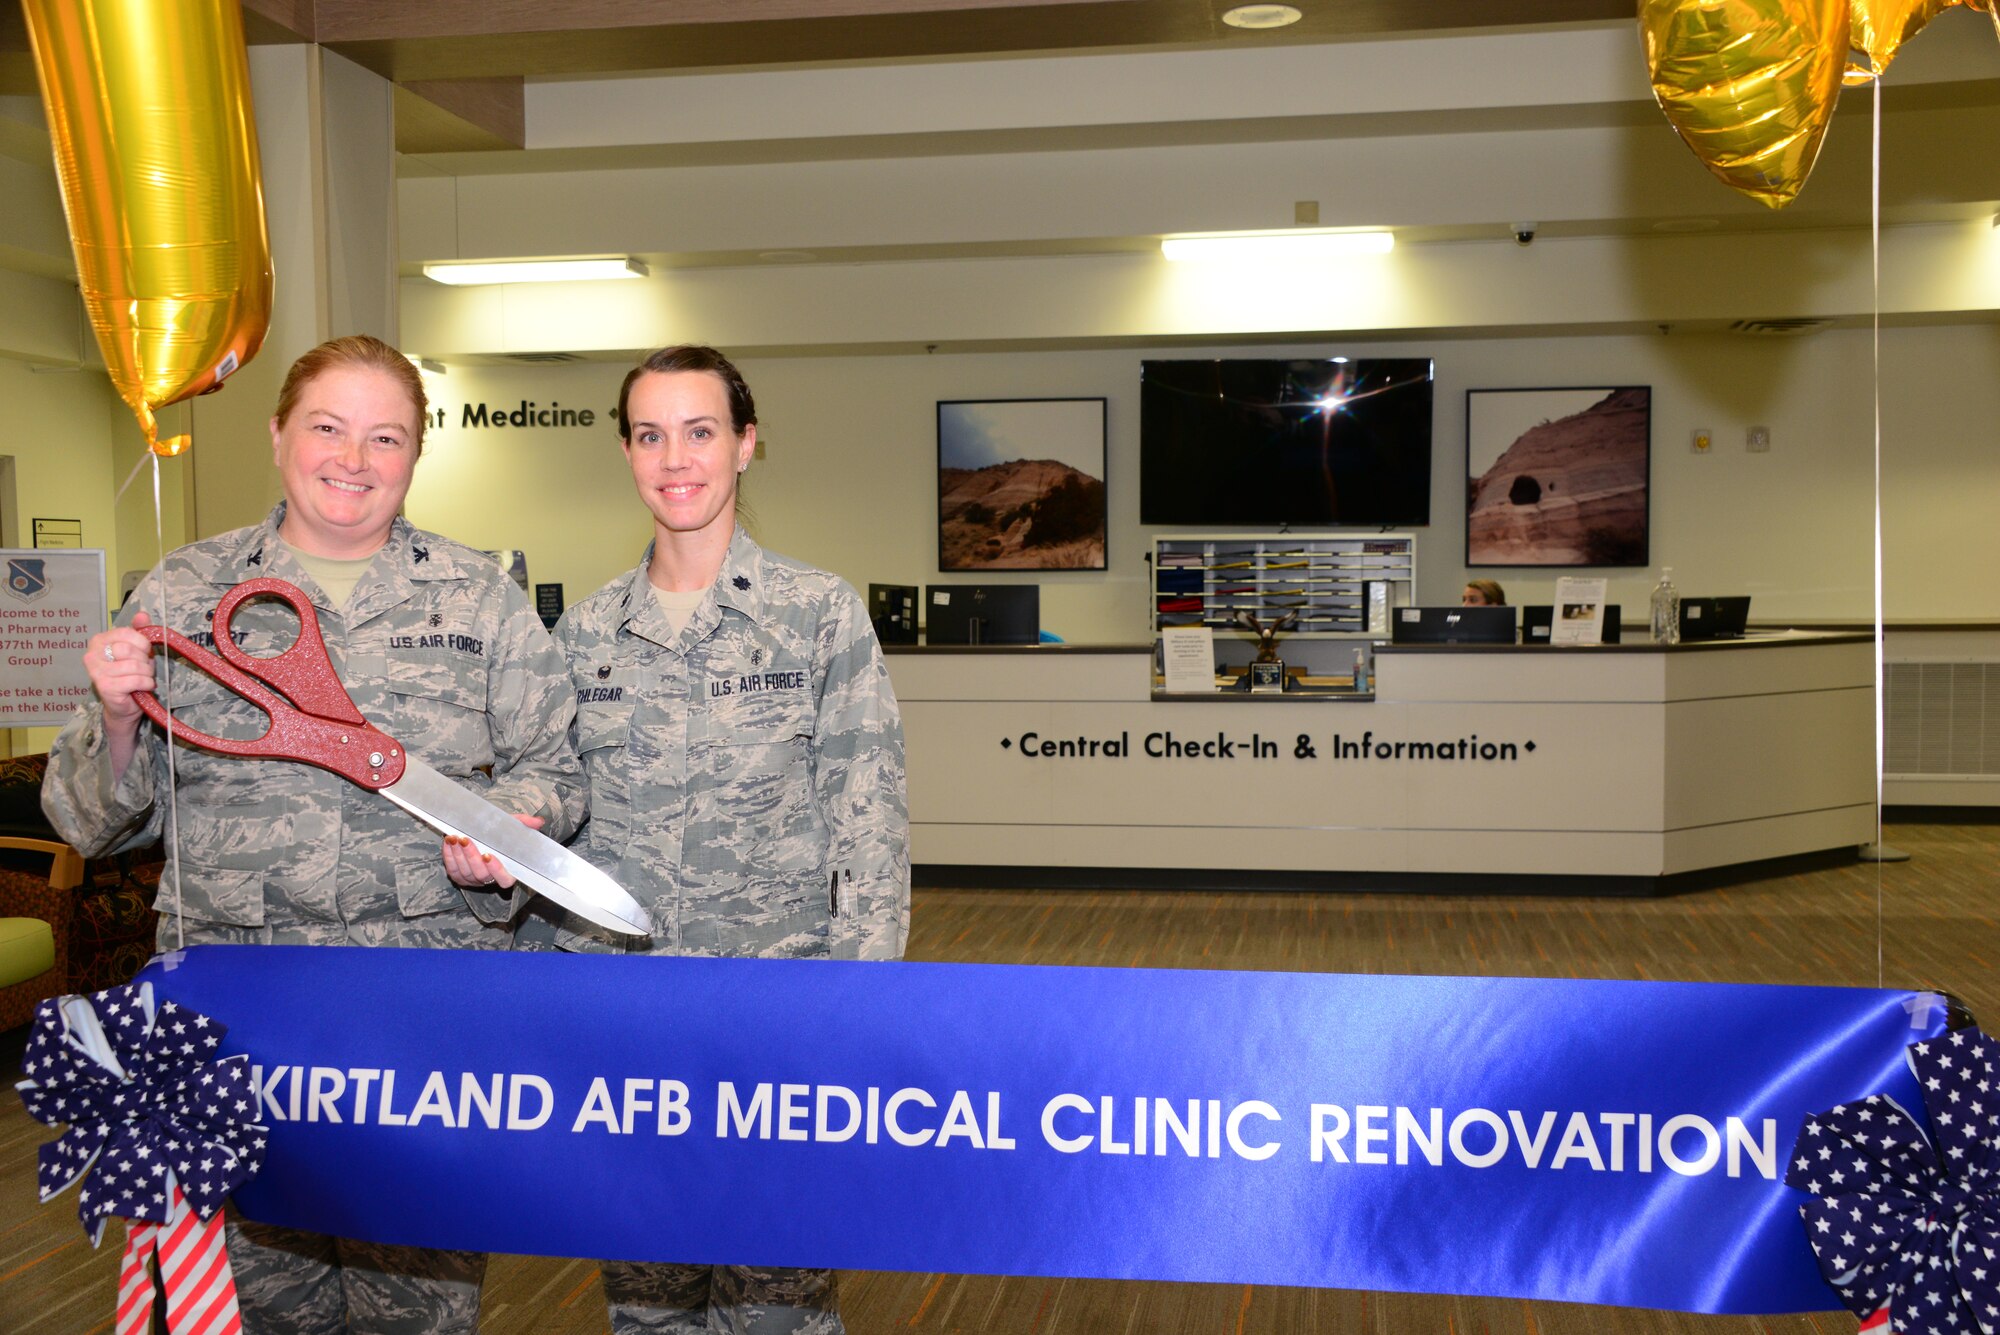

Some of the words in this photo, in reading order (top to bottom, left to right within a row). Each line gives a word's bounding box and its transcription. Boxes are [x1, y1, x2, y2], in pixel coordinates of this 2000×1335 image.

[462, 400, 595, 428] Medicine
[42, 609, 54, 618] to
[59, 608, 79, 618] the
[8, 624, 71, 635] Pharmacy
[75, 624, 87, 633] at
[38, 639, 88, 649] Medical
[390, 636, 415, 648] U.S.
[420, 634, 445, 648] AIR
[448, 634, 483, 656] FORCE
[8, 655, 53, 667] Group!
[711, 680, 735, 697] U.S.
[740, 674, 761, 693] AIR
[764, 672, 804, 690] FORCE
[15, 687, 42, 697] take
[47, 688, 54, 696] a
[18, 702, 39, 712] the
[43, 701, 77, 712] Kiosk
[1019, 731, 1128, 757] Central
[1144, 732, 1278, 758] Check-In
[1294, 734, 1317, 759] &
[1333, 733, 1517, 760] Information
[253, 1065, 554, 1131] KIRTLAND
[572, 1076, 692, 1136] AFB
[716, 1081, 1016, 1150] MEDICAL
[1041, 1093, 1281, 1161] CLINIC
[1309, 1103, 1777, 1180] RENOVATION
